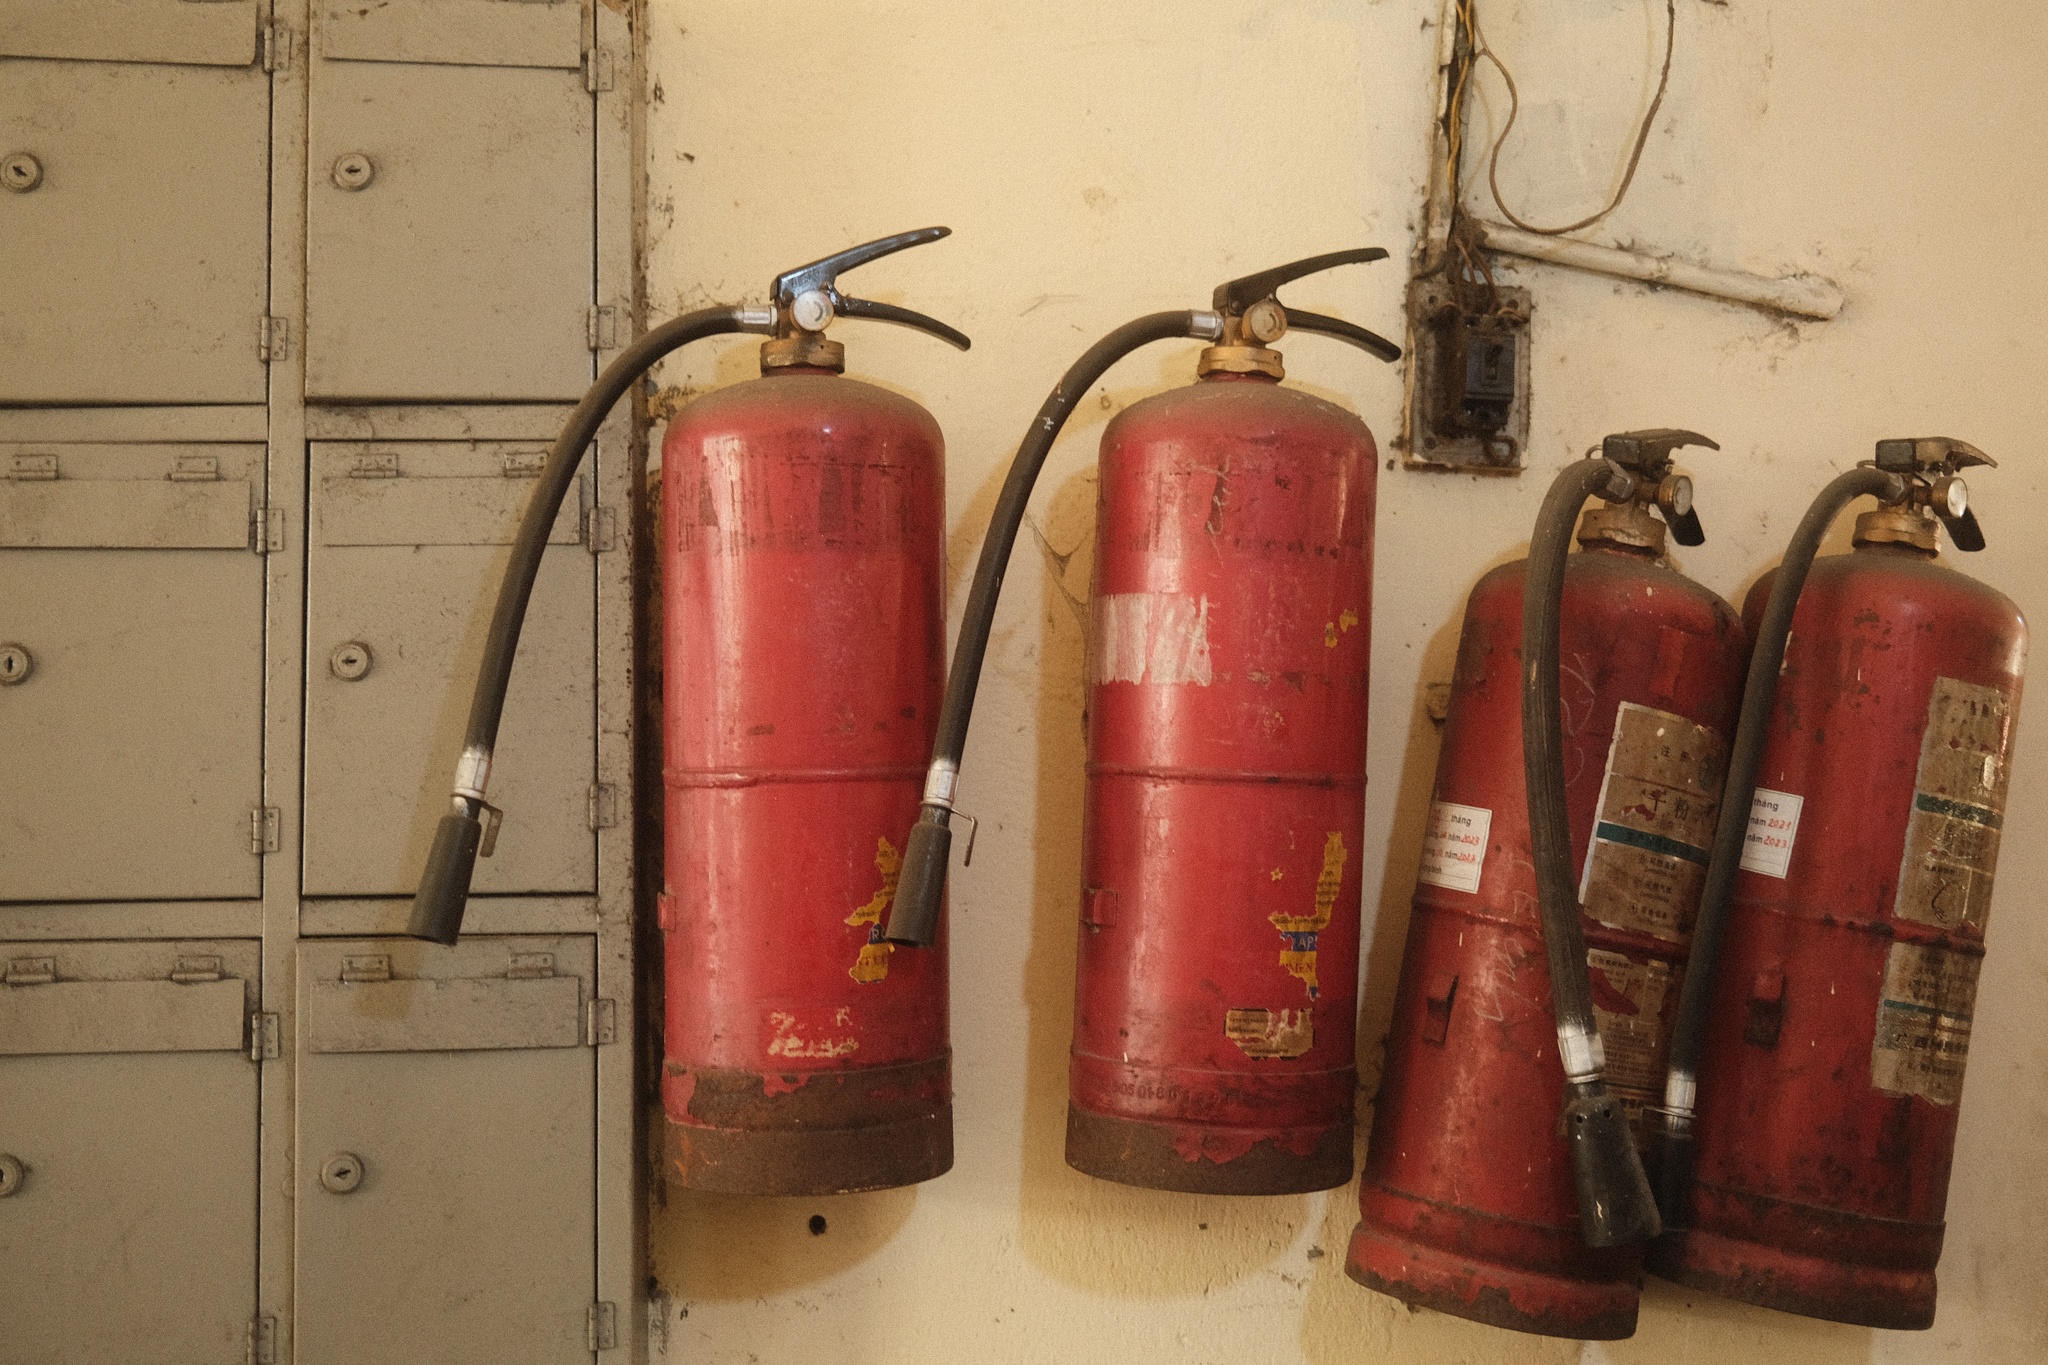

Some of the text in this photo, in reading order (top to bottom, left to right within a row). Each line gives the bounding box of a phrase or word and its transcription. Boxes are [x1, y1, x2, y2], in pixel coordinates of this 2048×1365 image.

[1753, 798, 1779, 812] tháng
[1450, 814, 1472, 827] tháng
[1749, 816, 1766, 826] năm
[1746, 833, 1763, 843] năm
